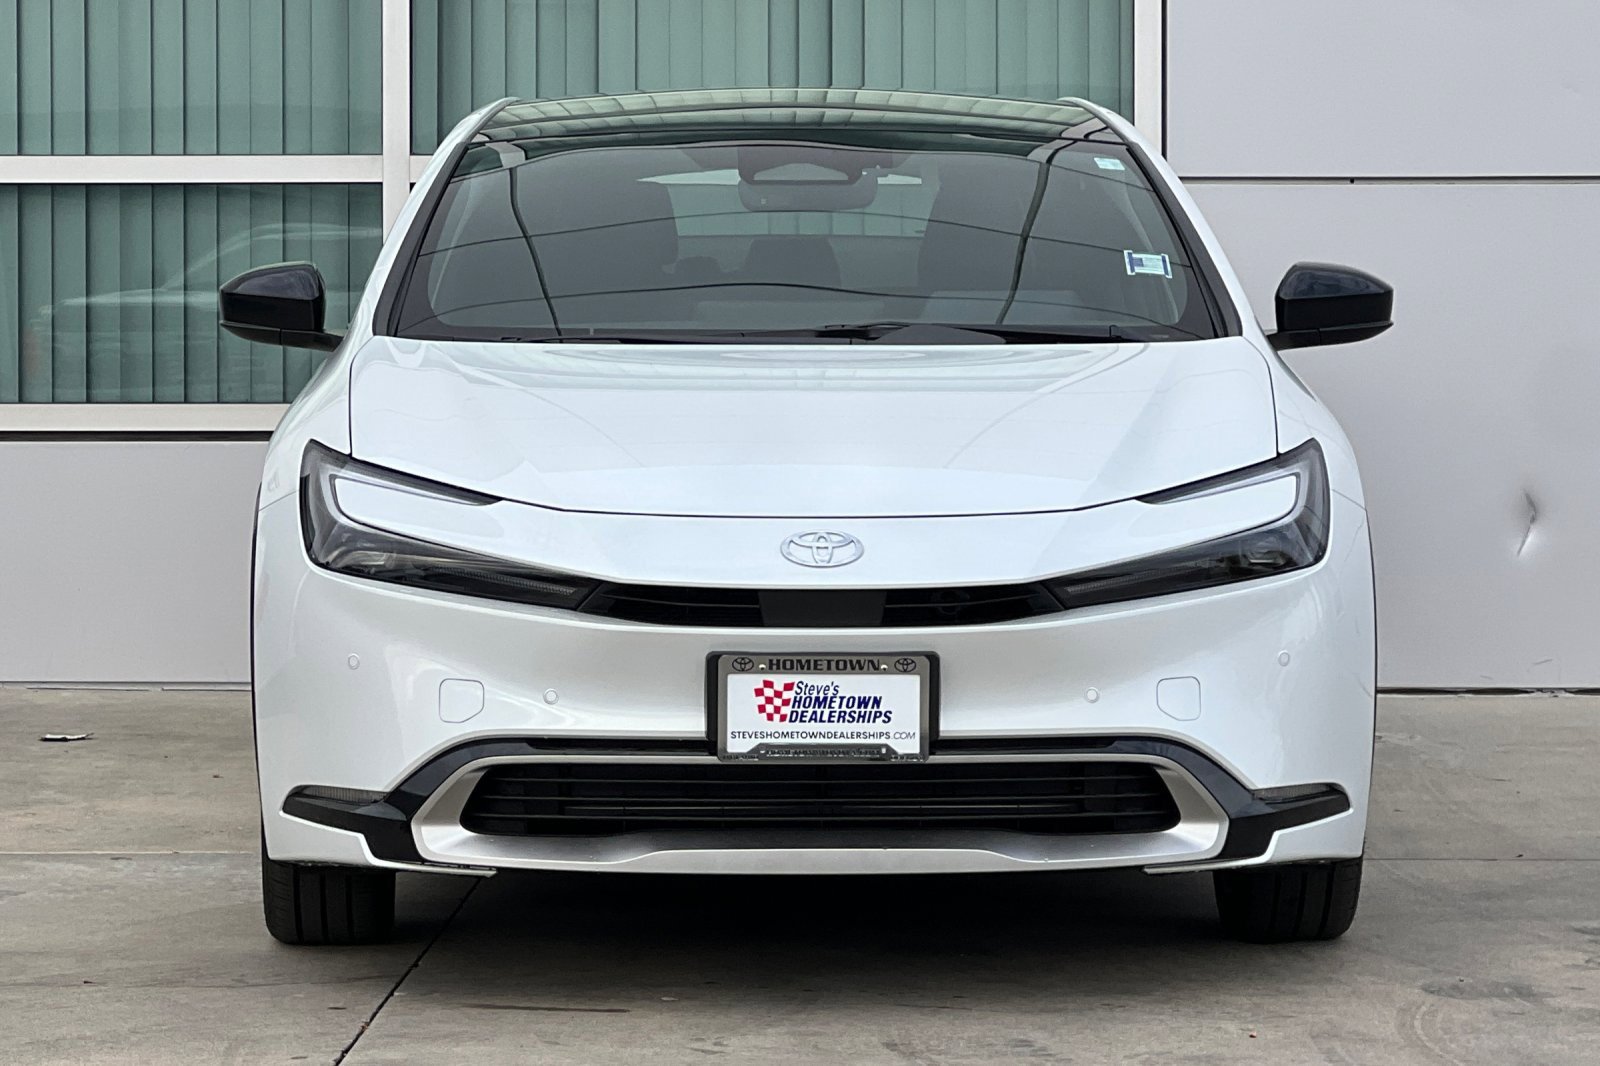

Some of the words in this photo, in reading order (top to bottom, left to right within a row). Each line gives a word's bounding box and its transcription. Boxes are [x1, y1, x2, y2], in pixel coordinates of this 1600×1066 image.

[768, 658, 881, 671] HOMETOWN
[794, 680, 839, 696] Steve's
[791, 695, 882, 709] HOMETOWN
[788, 710, 893, 724] DEALERSHIPS
[730, 730, 916, 740] STEVESHOMETOWNDEALERSHIPS.COM
